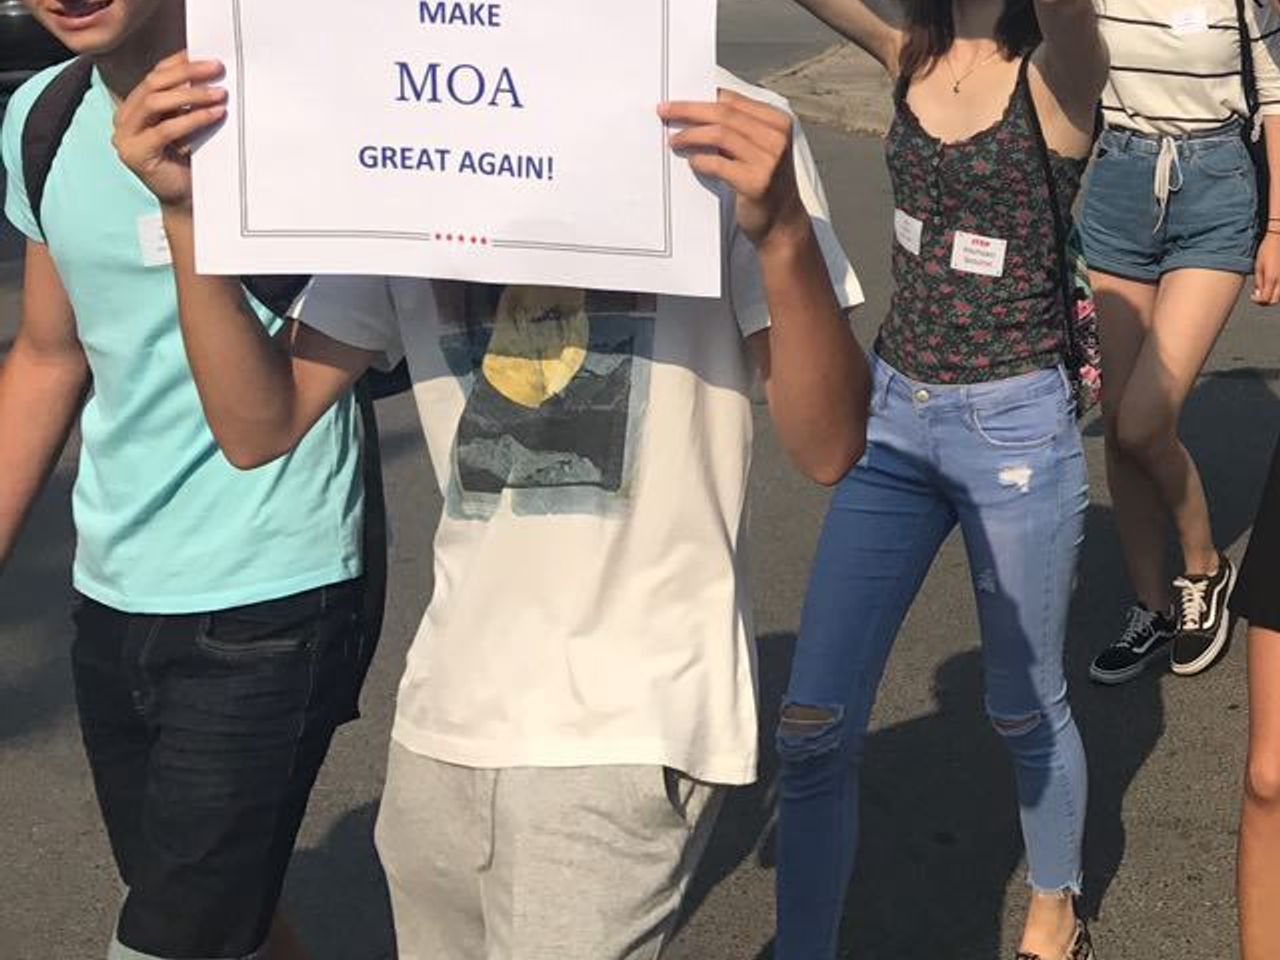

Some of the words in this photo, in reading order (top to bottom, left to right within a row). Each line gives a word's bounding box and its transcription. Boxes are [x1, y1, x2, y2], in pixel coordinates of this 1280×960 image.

[418, 0, 501, 28] MAKE
[393, 61, 524, 109] MOA
[358, 145, 451, 172] GREAT
[458, 150, 555, 181] AGAIN!
